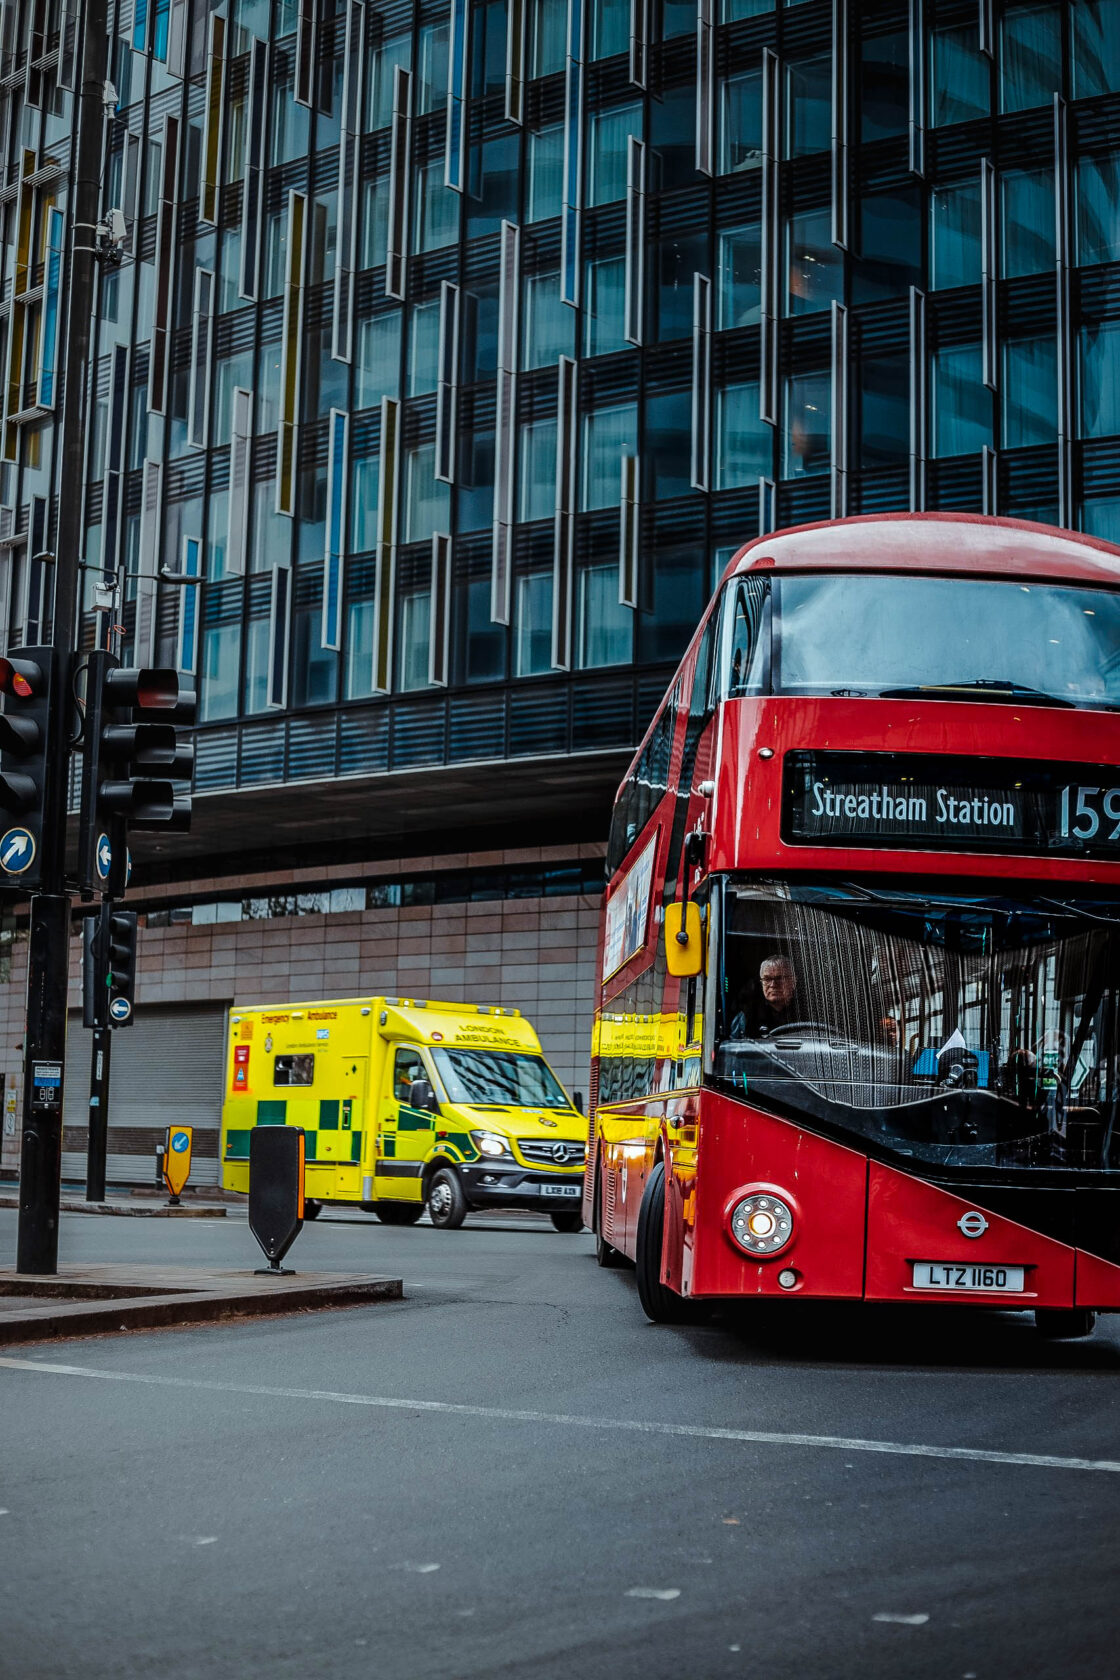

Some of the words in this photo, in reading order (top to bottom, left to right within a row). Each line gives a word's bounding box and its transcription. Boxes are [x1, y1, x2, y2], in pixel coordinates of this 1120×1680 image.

[812, 782, 927, 821] Streatham
[935, 789, 1014, 826] Station
[1061, 786, 1120, 840] 159
[455, 1034, 521, 1047] AMBULANCE
[458, 1025, 506, 1035] LONDON
[929, 1266, 967, 1286] LTZ
[971, 1268, 1008, 1288] 1160
